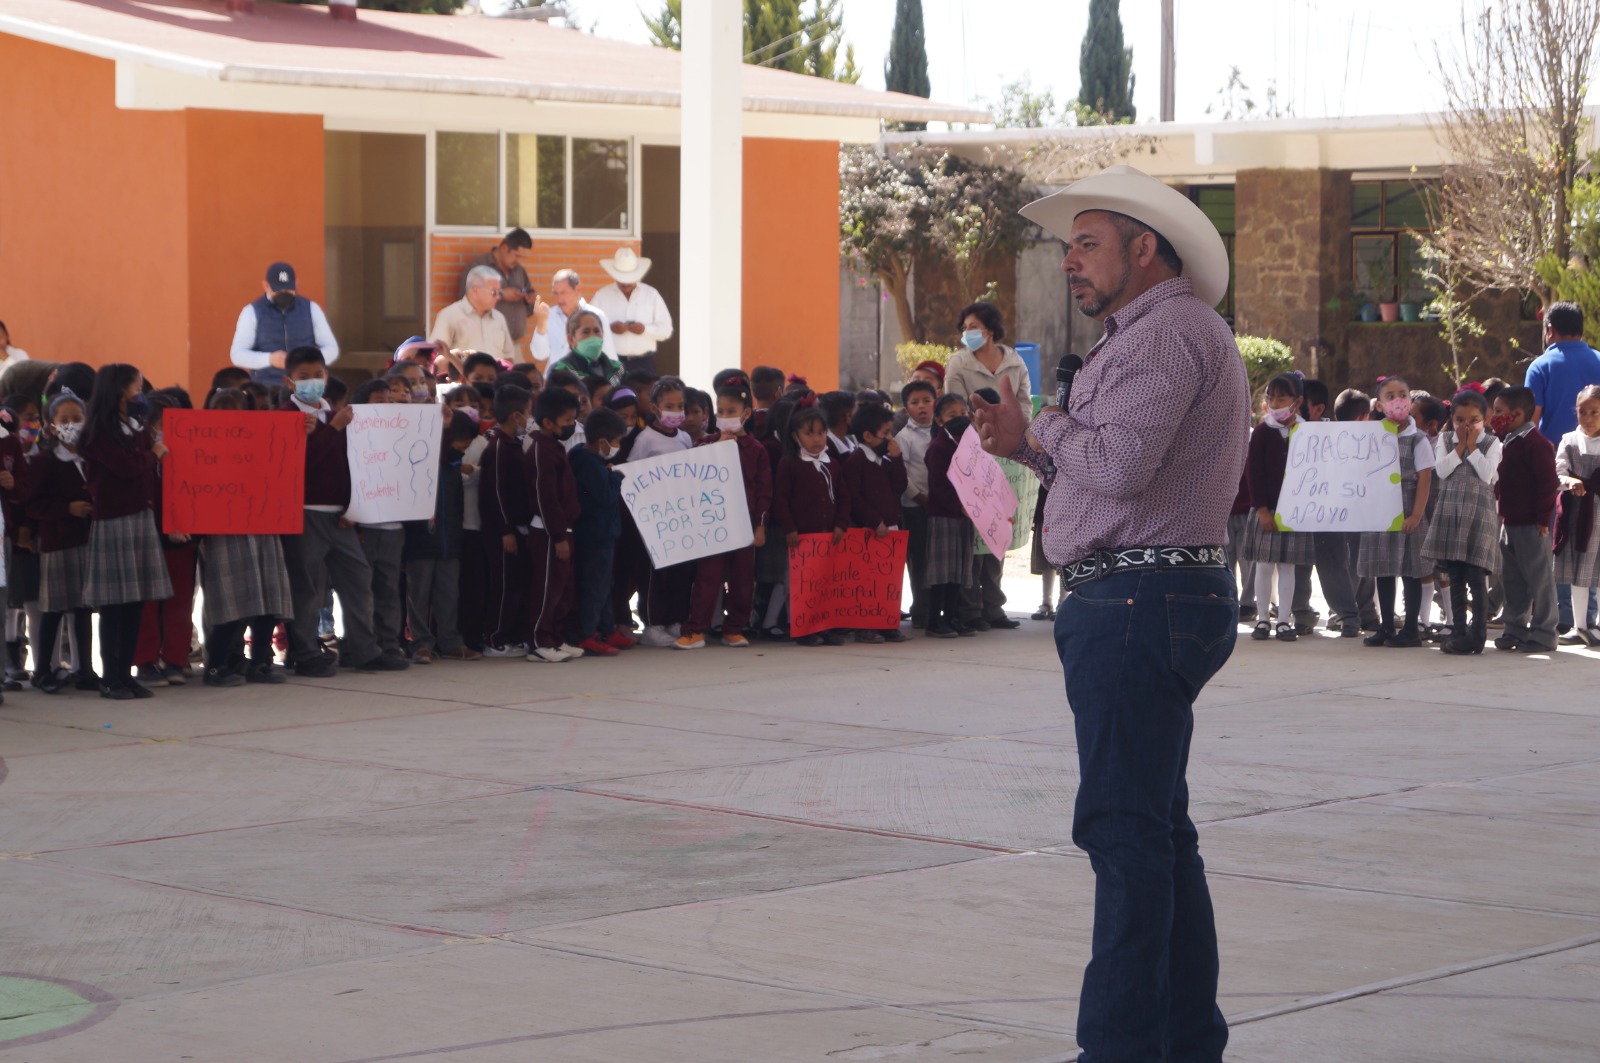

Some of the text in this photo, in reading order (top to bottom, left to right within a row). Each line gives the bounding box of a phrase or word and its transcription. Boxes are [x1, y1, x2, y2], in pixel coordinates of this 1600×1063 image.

[194, 448, 219, 465] Por
[1342, 482, 1366, 498] SU
[637, 489, 725, 523] GRACIAS
[1287, 501, 1349, 524] APOYO
[656, 507, 726, 540] POR SU
[648, 526, 728, 562] APOYO
[835, 602, 888, 618] recibido
